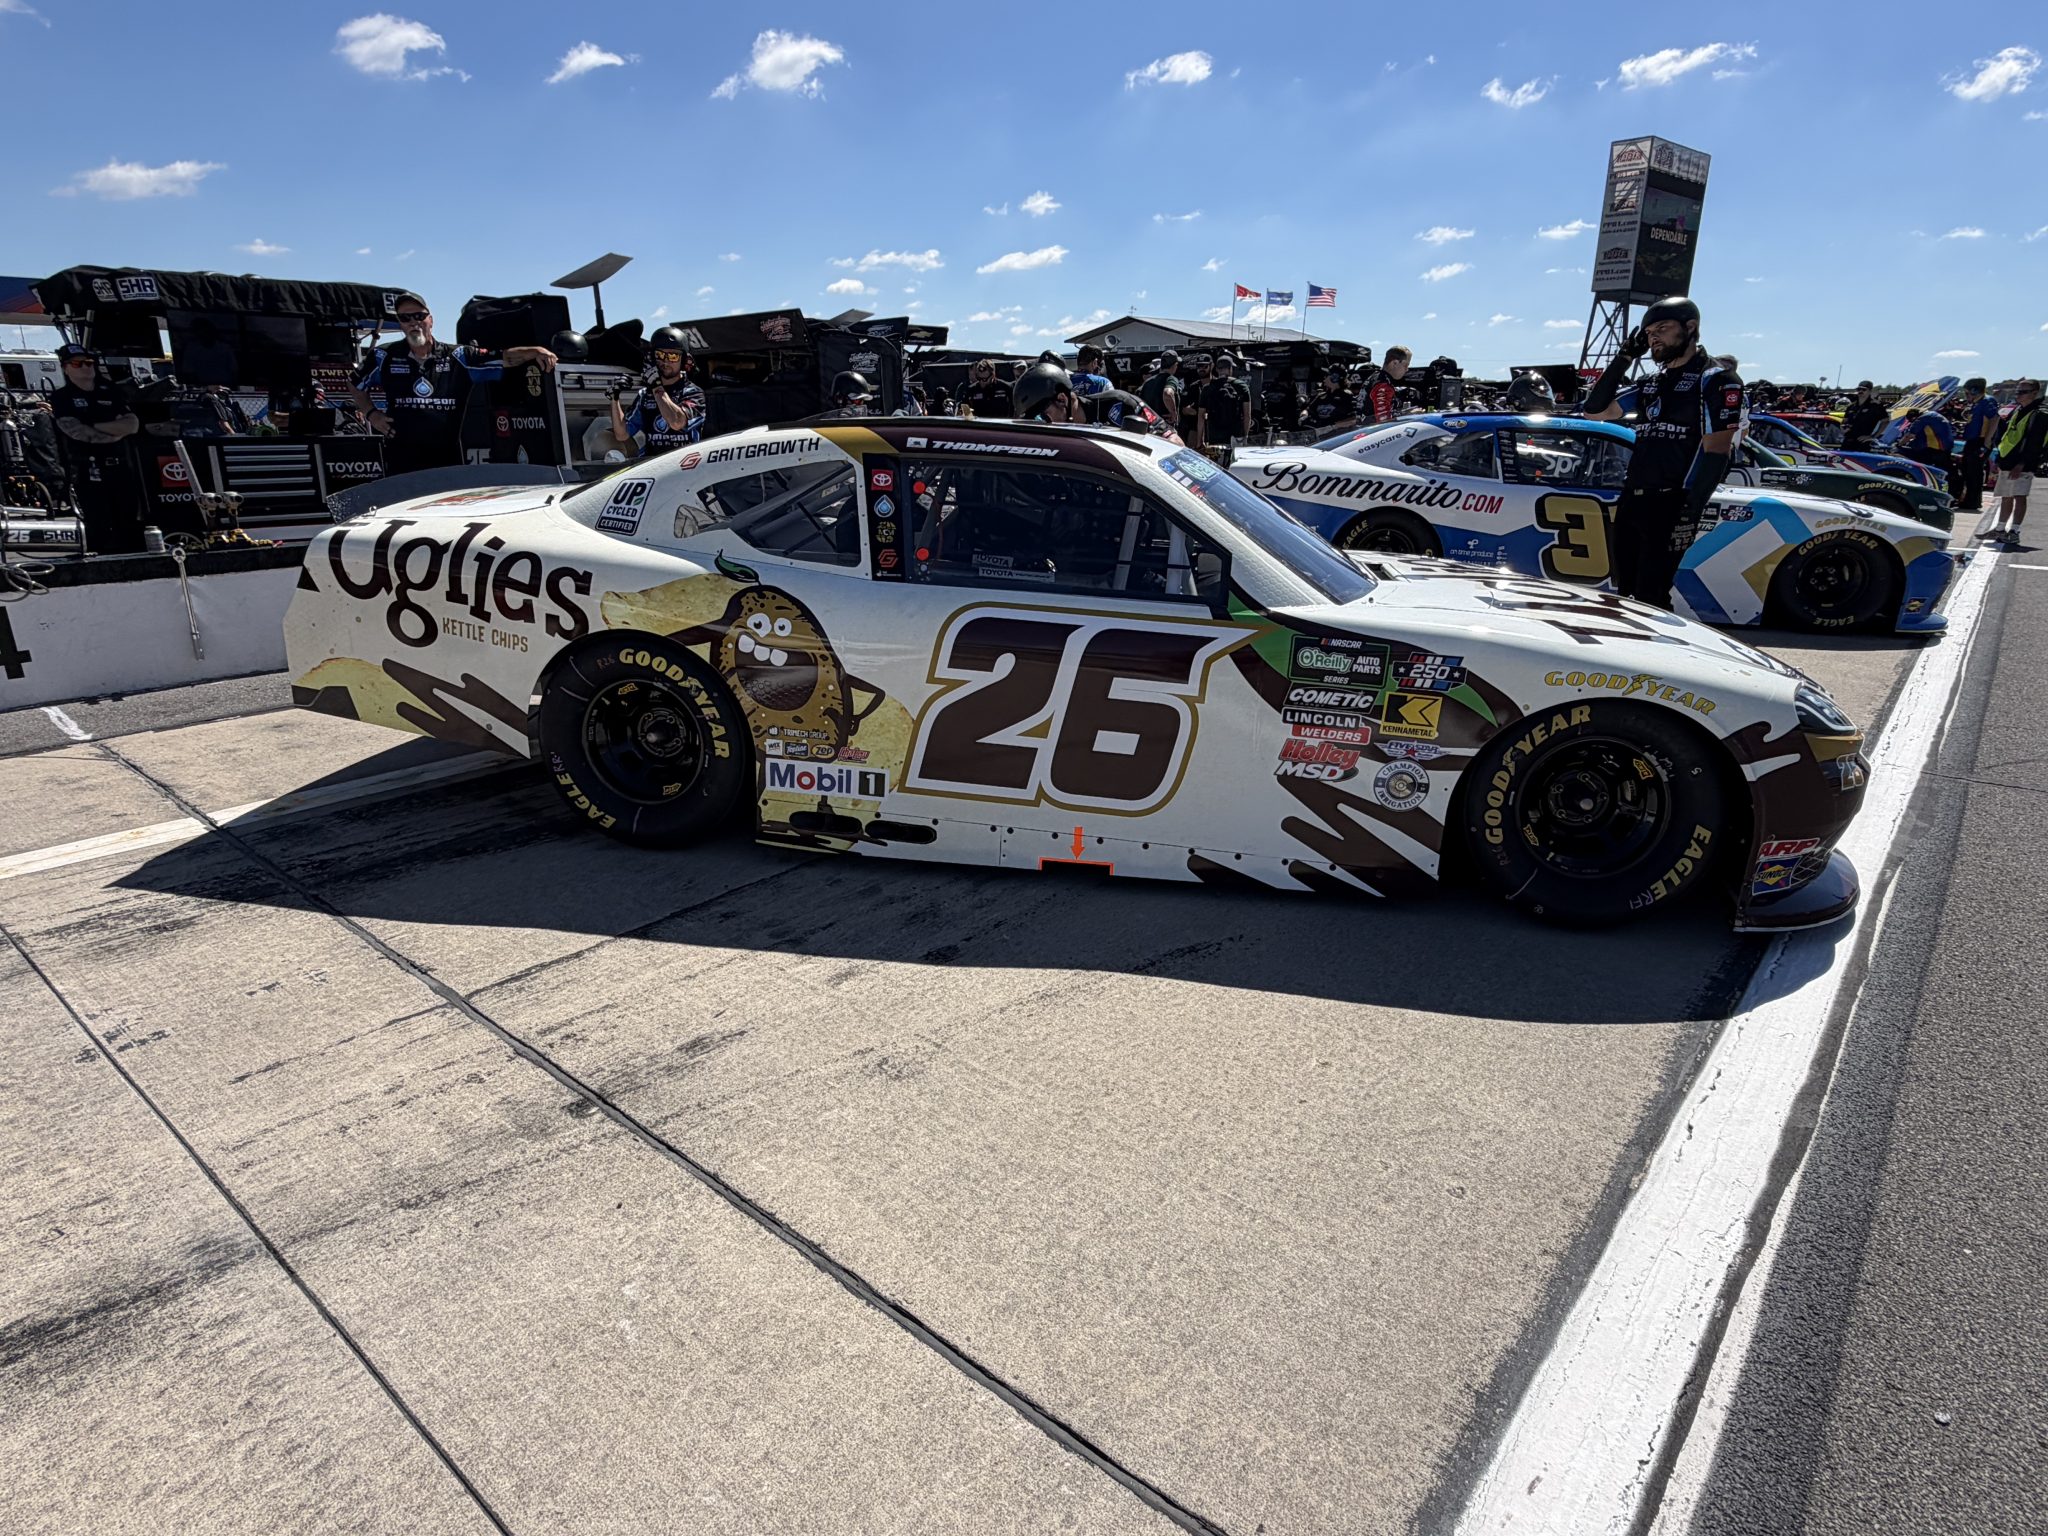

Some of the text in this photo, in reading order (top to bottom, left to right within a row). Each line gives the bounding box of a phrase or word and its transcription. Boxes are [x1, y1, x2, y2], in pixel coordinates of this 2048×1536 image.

[1650, 226, 1689, 246] DEPENDABLE
[118, 278, 155, 293] SHR
[1113, 357, 1132, 372] 27
[511, 416, 546, 430] TOYOTA
[706, 437, 821, 464] GRITGROWTH
[931, 440, 1060, 457] THOMPSON
[1358, 431, 1403, 455] easycare
[326, 461, 383, 474] TOYOTA
[612, 482, 648, 506] UP
[1857, 481, 1908, 494] GOODYEAR
[606, 505, 638, 518] CYCLED
[600, 518, 634, 531] CERTIFIED
[1815, 517, 1888, 533] GOODYEAR
[981, 568, 1014, 578] TOYOTA
[328, 519, 594, 648] Uglies
[442, 617, 529, 653] KETTLE CHIPS
[1329, 638, 1363, 649] NASCAR
[1298, 647, 1380, 673] O'Reilly AUTO
[1352, 664, 1381, 675] PARTS
[1409, 663, 1451, 679] 250
[1323, 675, 1350, 685] SERIES
[1288, 687, 1375, 709] COMETIC
[1543, 670, 1717, 717] GOODYEAR
[618, 647, 731, 759] GOODYEAR
[908, 606, 1240, 812] 26
[1285, 710, 1357, 728] LINCOLN
[1300, 726, 1363, 742] WELDERS
[1382, 725, 1433, 738] KENNAMETAL
[1280, 738, 1360, 771] Holley
[1388, 741, 1412, 750] FIVE
[769, 762, 877, 796] Mobil 1
[1275, 761, 1346, 781] MSD
[1382, 762, 1427, 780] CHAMPION
[1484, 704, 1592, 845] GOODYEAR
[556, 772, 617, 829] EAGLE
[1377, 790, 1422, 809] IRRIGATION
[1758, 838, 1820, 858] ARP
[1650, 823, 1713, 902] EAGLE
[1755, 867, 1792, 882] SUNOCO
